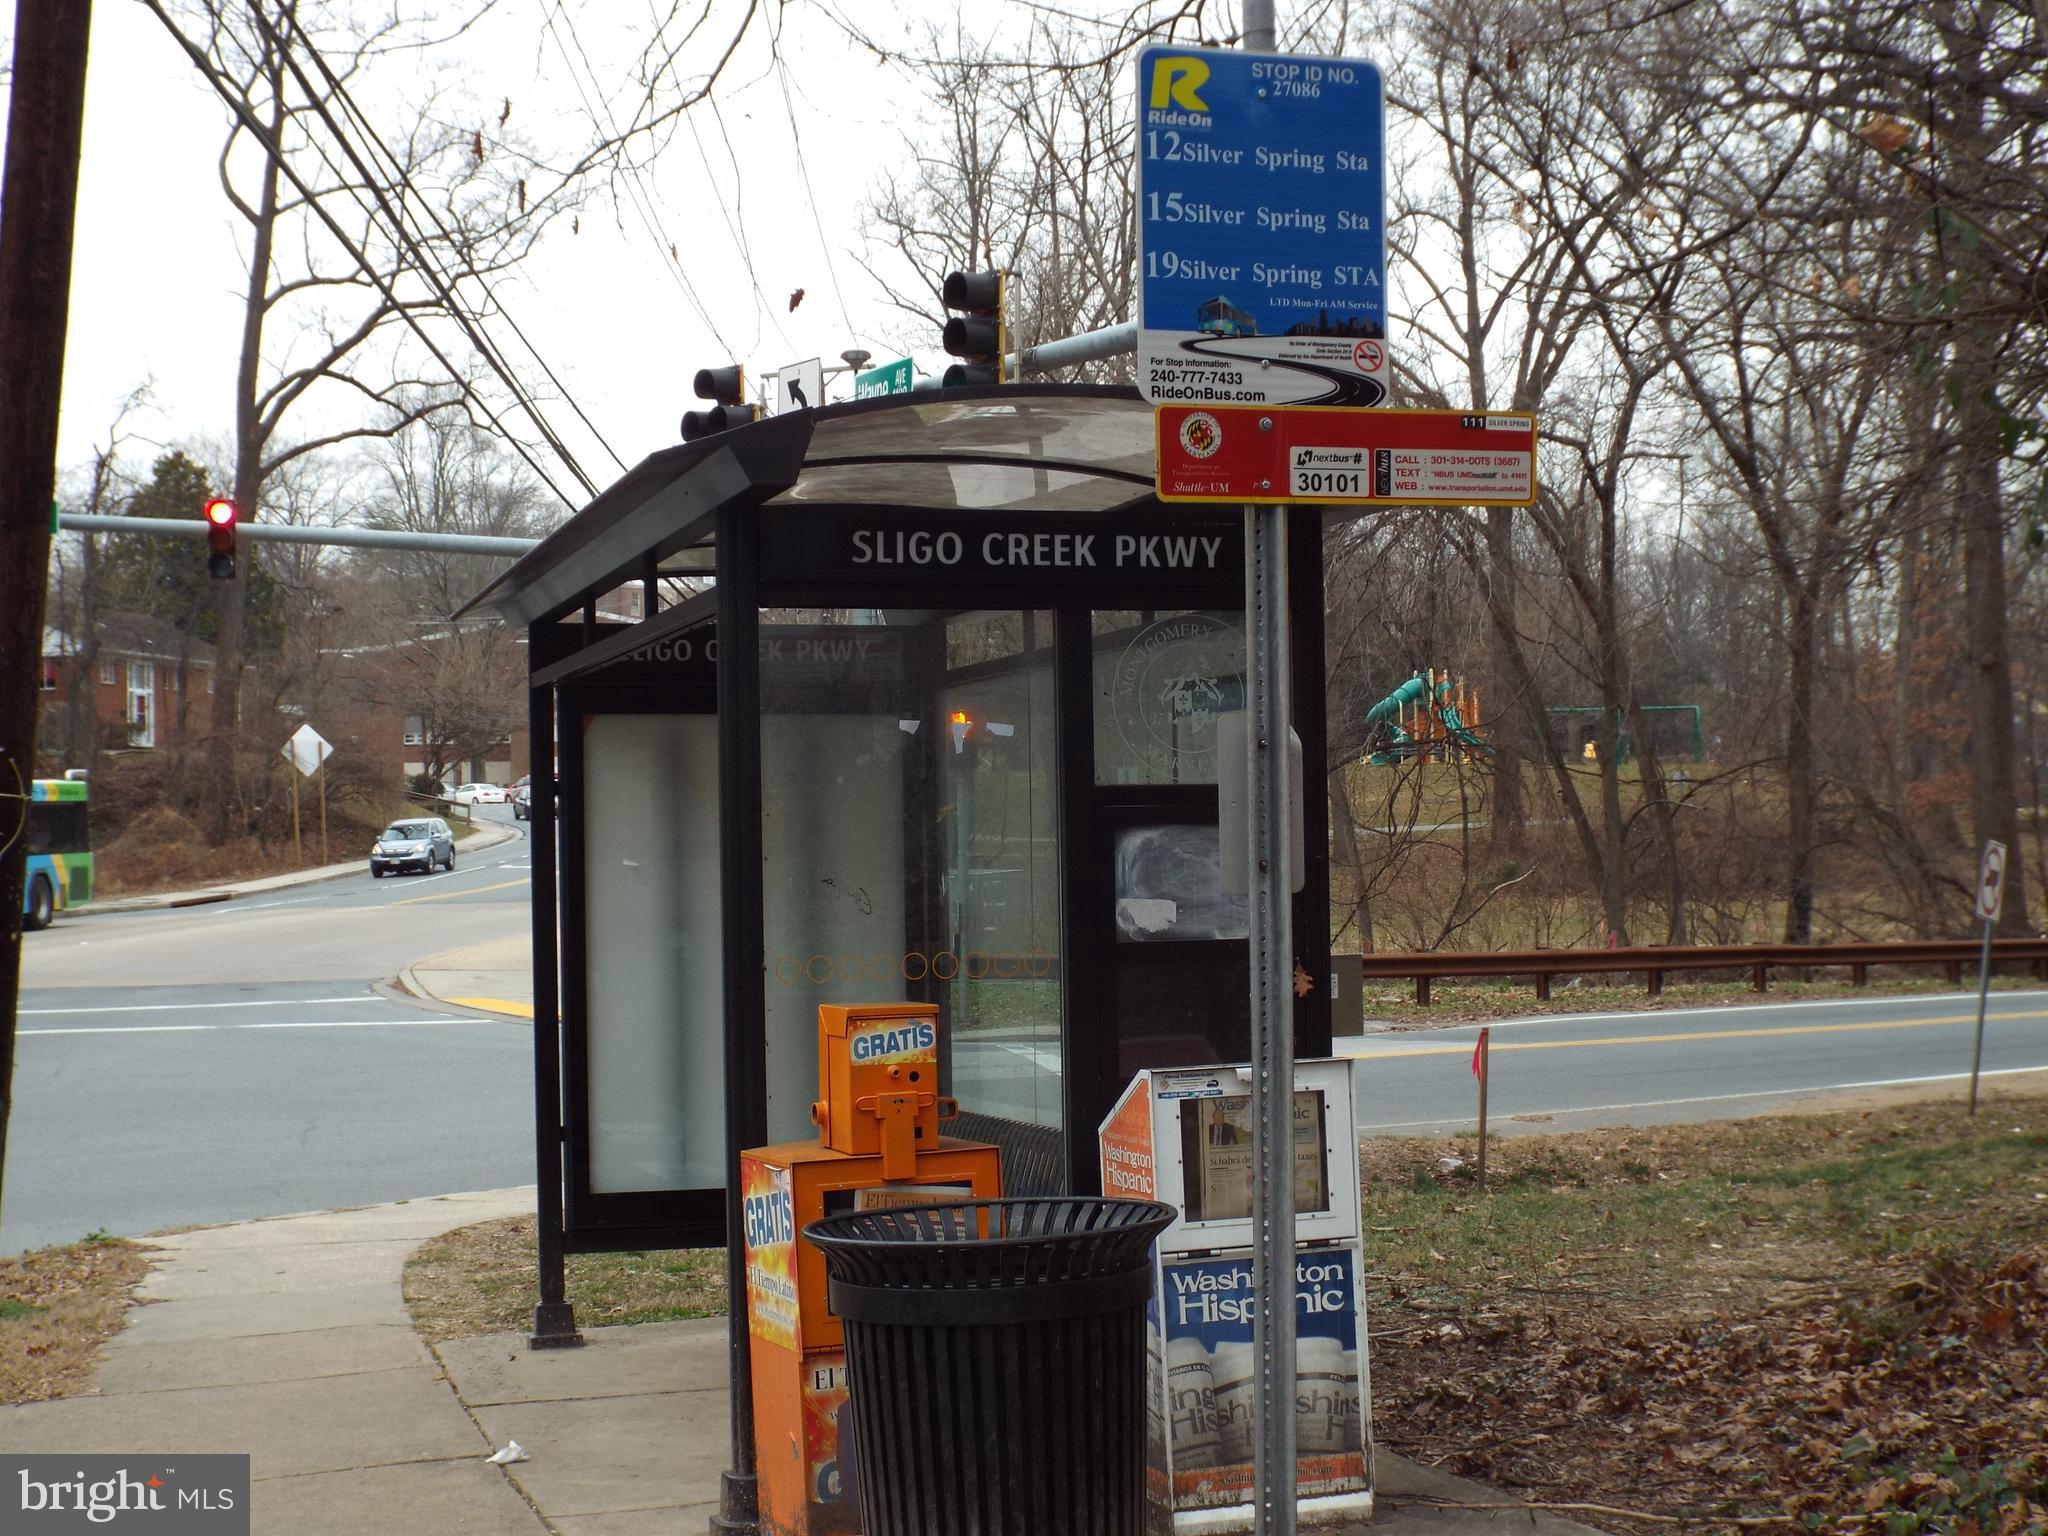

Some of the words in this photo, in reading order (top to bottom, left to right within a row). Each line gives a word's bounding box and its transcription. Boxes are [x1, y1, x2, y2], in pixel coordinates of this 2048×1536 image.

[1150, 56, 1211, 112] R
[1252, 62, 1300, 79] STOP
[1305, 65, 1322, 81] ID
[1328, 67, 1359, 84] NO.
[1272, 81, 1320, 98] 27086
[1255, 146, 1325, 174] Spring
[1336, 151, 1368, 171] Sta
[1257, 207, 1326, 233] Spring
[1337, 211, 1369, 231] Sta
[1253, 262, 1322, 289] Spring
[1334, 265, 1380, 286] STA
[1270, 298, 1290, 307] LTD
[1292, 298, 1328, 308] Mon-Fri
[1330, 300, 1346, 309] AM
[1347, 301, 1378, 310] Service
[1150, 358, 1164, 366] For
[1166, 358, 1184, 368] Stop
[1185, 359, 1232, 369] Information:
[1151, 370, 1243, 385] 240-777-7433
[1151, 385, 1266, 401] RideOnBus.com
[1463, 417, 1484, 427] 111
[1395, 455, 1420, 465] CALL
[1431, 456, 1491, 466] 301-314-DOTS
[1494, 457, 1520, 467] (3687)
[1298, 473, 1359, 492] 30101
[1395, 468, 1421, 478] TEXT
[1395, 481, 1418, 491] WEB
[852, 530, 963, 565] SLIGO
[982, 532, 1097, 567] CREEK
[1115, 534, 1223, 569] PKWY
[853, 1024, 934, 1060] GRATIS
[1104, 1140, 1152, 1169] Washington
[1106, 1160, 1152, 1194] Hispanic
[745, 1188, 793, 1249] GRATIS
[814, 1367, 834, 1390] El
